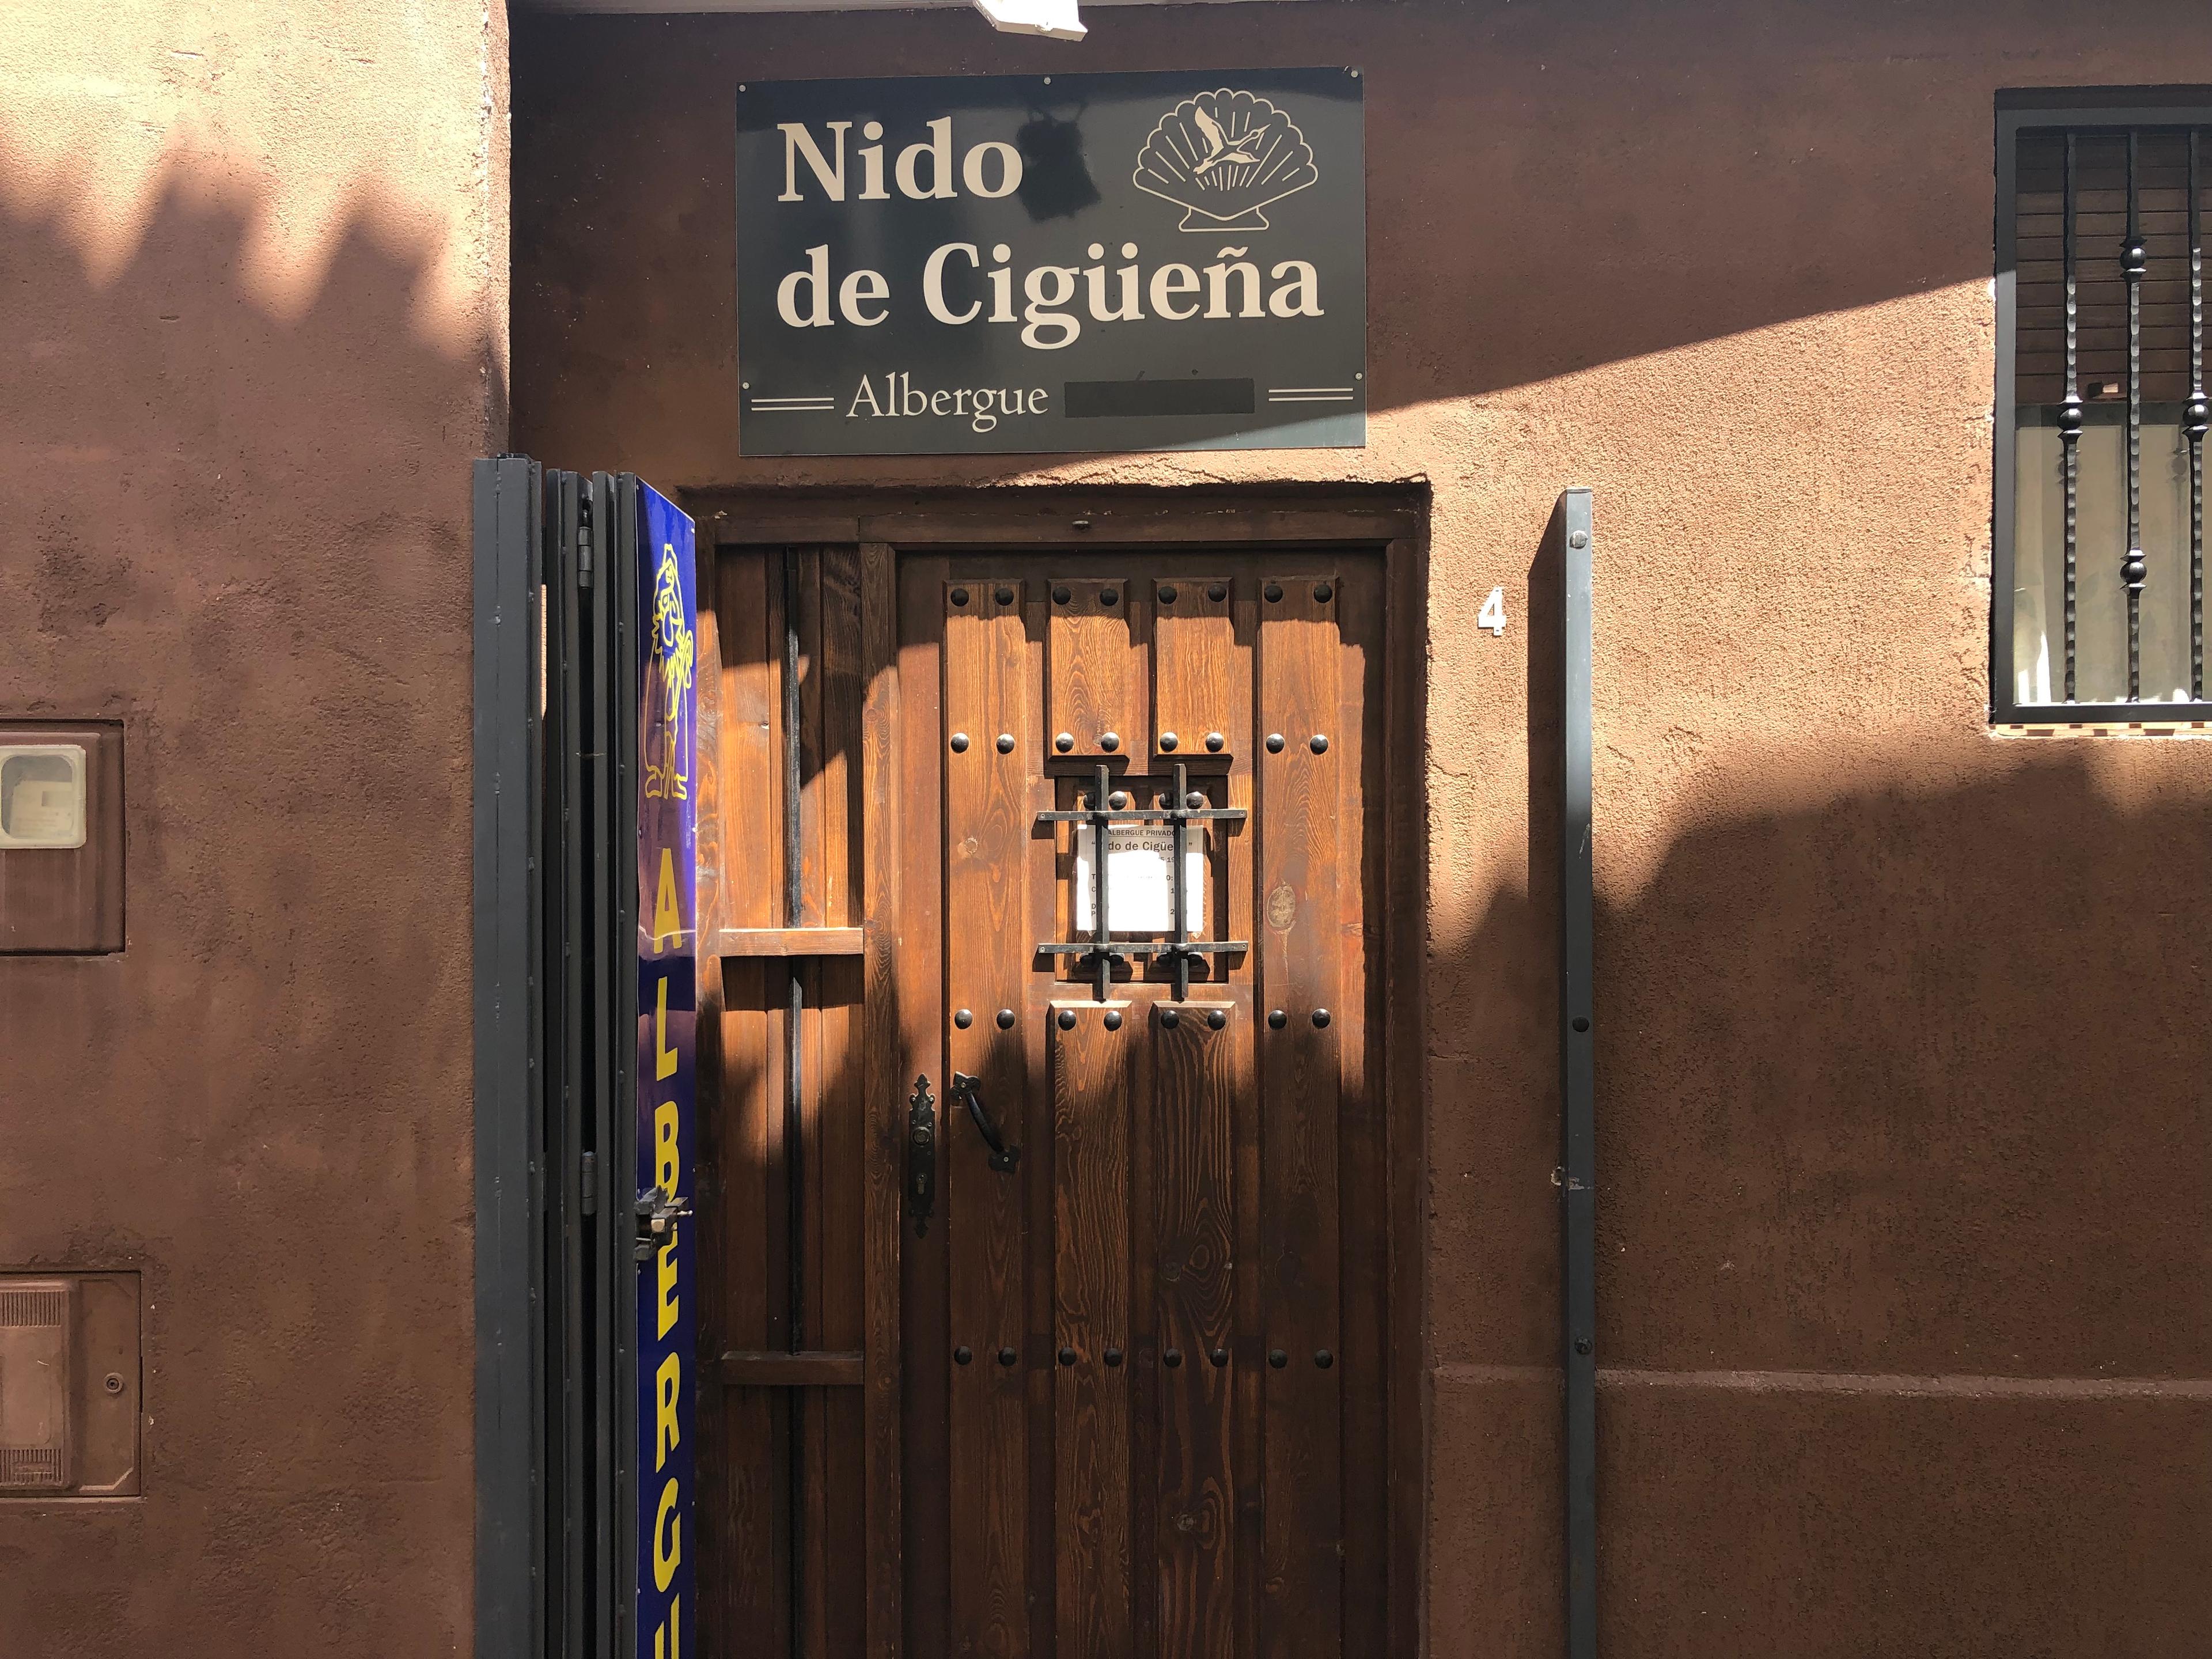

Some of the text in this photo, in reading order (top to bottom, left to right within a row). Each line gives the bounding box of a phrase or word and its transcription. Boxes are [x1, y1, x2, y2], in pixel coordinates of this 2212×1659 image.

[777, 116, 1023, 202] Nido
[777, 242, 1325, 350] de Cigüeña
[846, 371, 1048, 433] Albergue
[1478, 586, 1507, 636] 4
[1125, 841, 1139, 850] de
